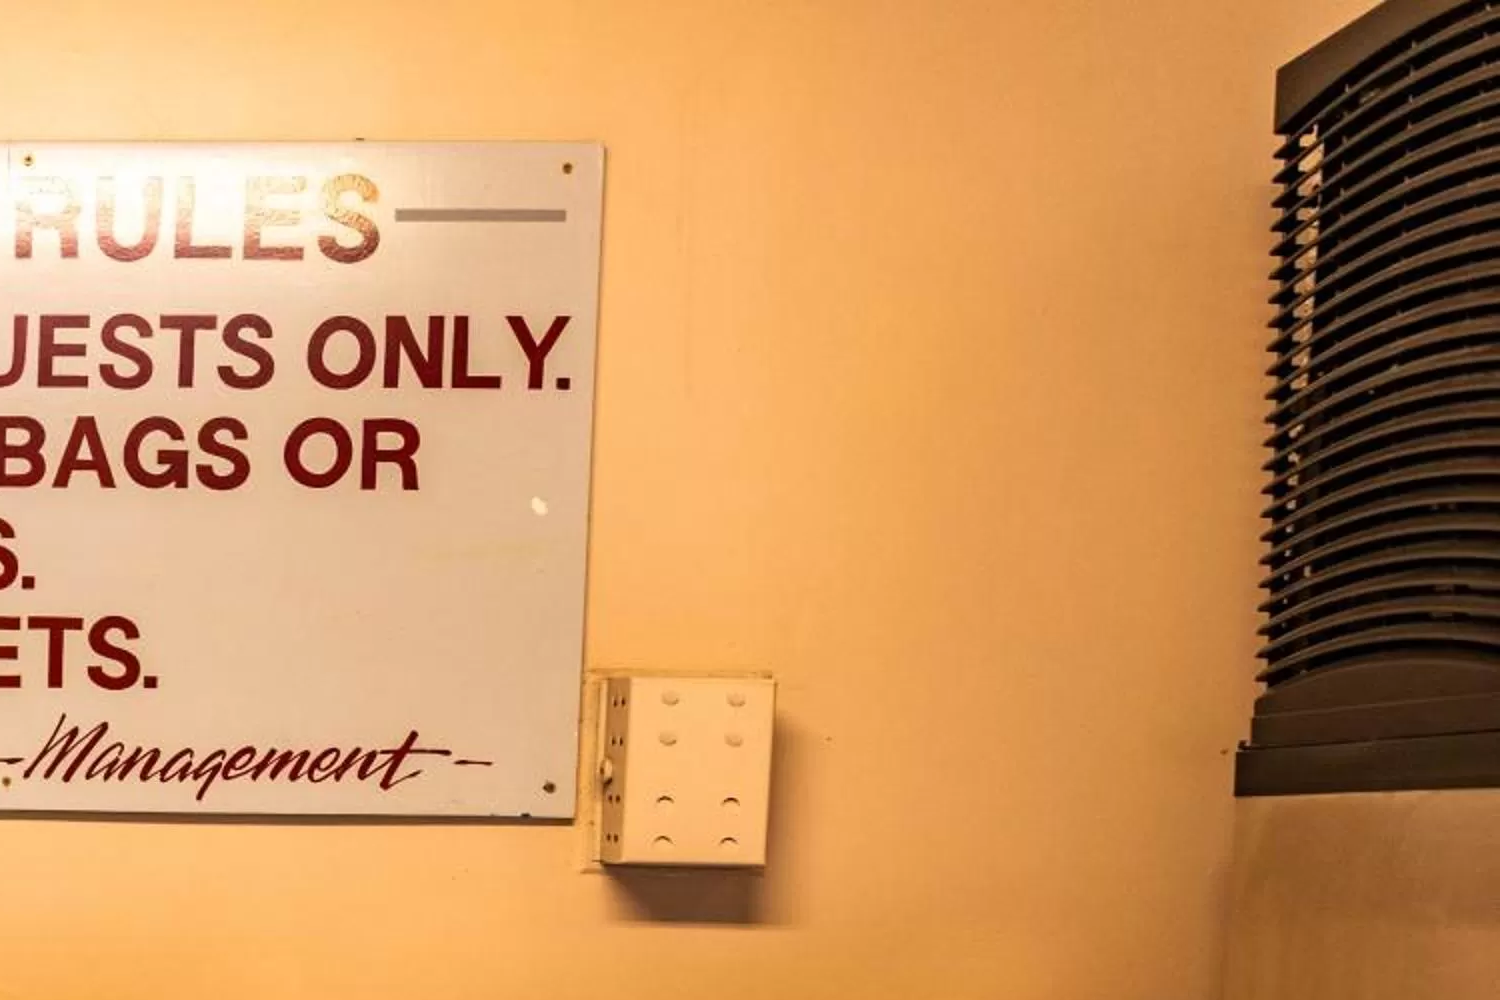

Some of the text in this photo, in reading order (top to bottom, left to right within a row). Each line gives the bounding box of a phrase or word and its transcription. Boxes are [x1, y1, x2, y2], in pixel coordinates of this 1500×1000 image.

[14, 172, 380, 264] RULES
[307, 316, 570, 390] ONLY.
[284, 417, 420, 490] OR
[23, 713, 451, 801] Management
